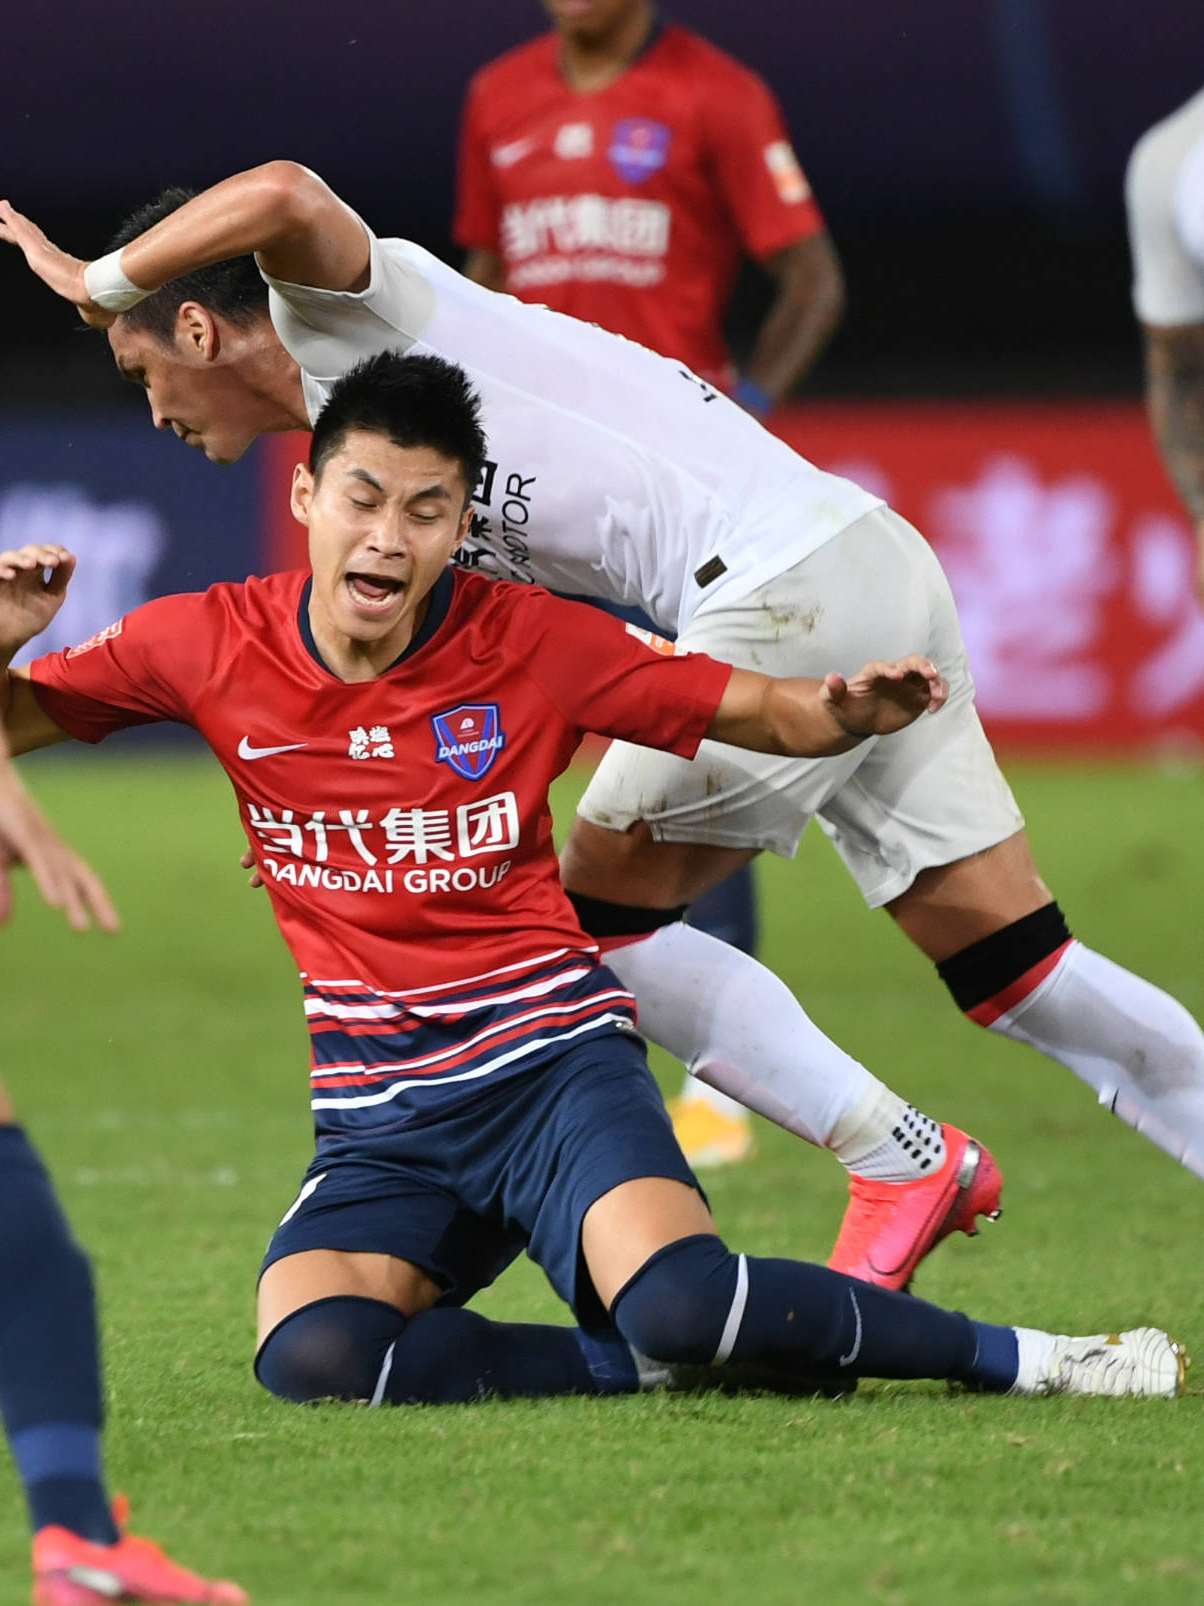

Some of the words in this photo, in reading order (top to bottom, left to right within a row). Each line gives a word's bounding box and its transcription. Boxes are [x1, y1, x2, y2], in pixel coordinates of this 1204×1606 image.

[439, 735, 503, 758] DANGDAI
[247, 791, 520, 866] 当代集团
[403, 860, 512, 893] GROUP
